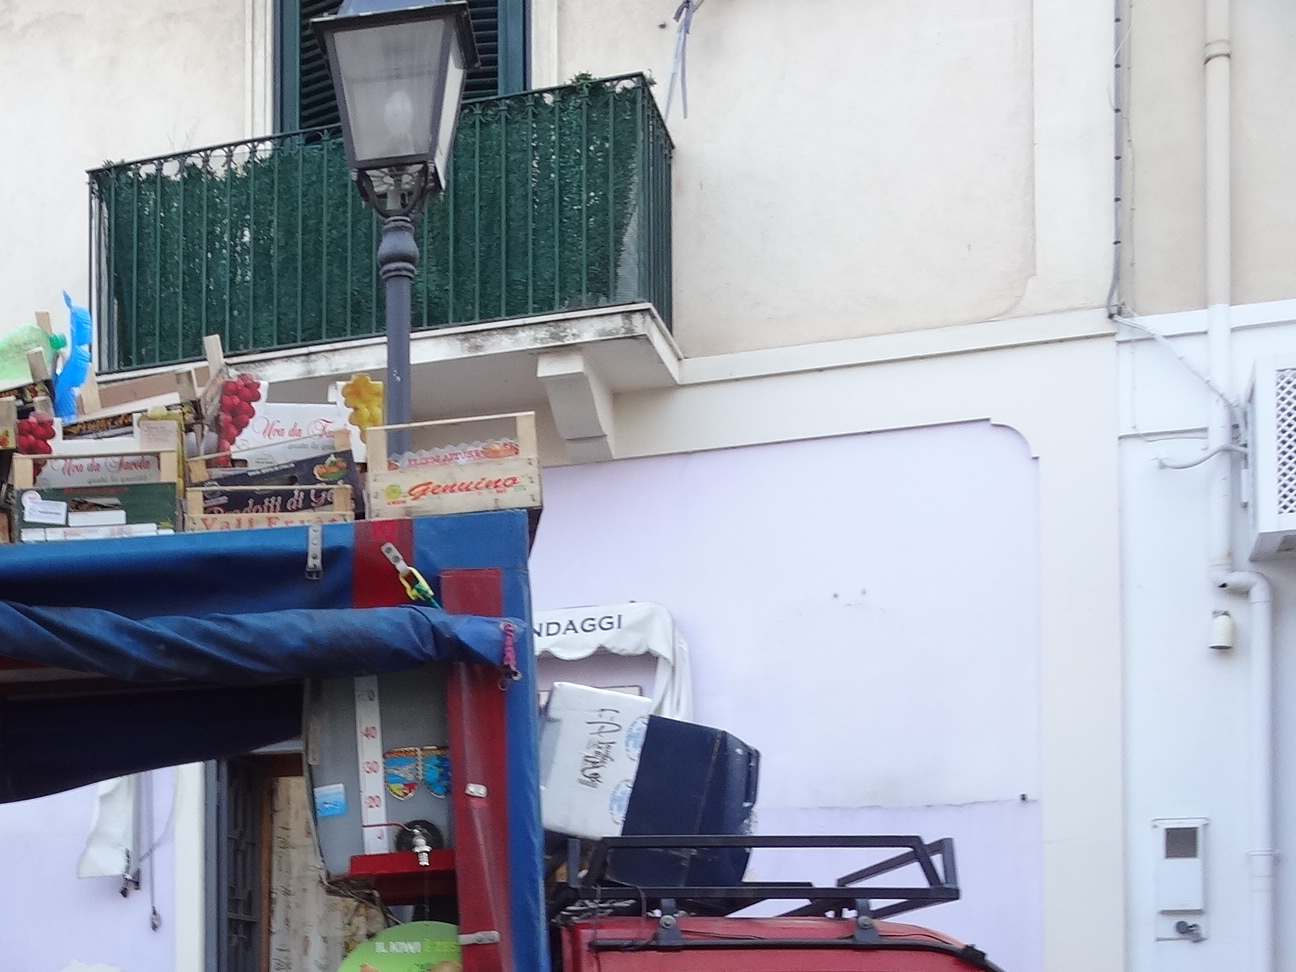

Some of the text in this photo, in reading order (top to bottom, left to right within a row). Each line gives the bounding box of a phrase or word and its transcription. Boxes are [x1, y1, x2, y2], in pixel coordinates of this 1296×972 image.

[288, 422, 302, 438] da
[52, 457, 84, 476] Uva
[87, 456, 100, 473] da
[407, 476, 520, 501] Genuino
[389, 941, 422, 954] KIWI
